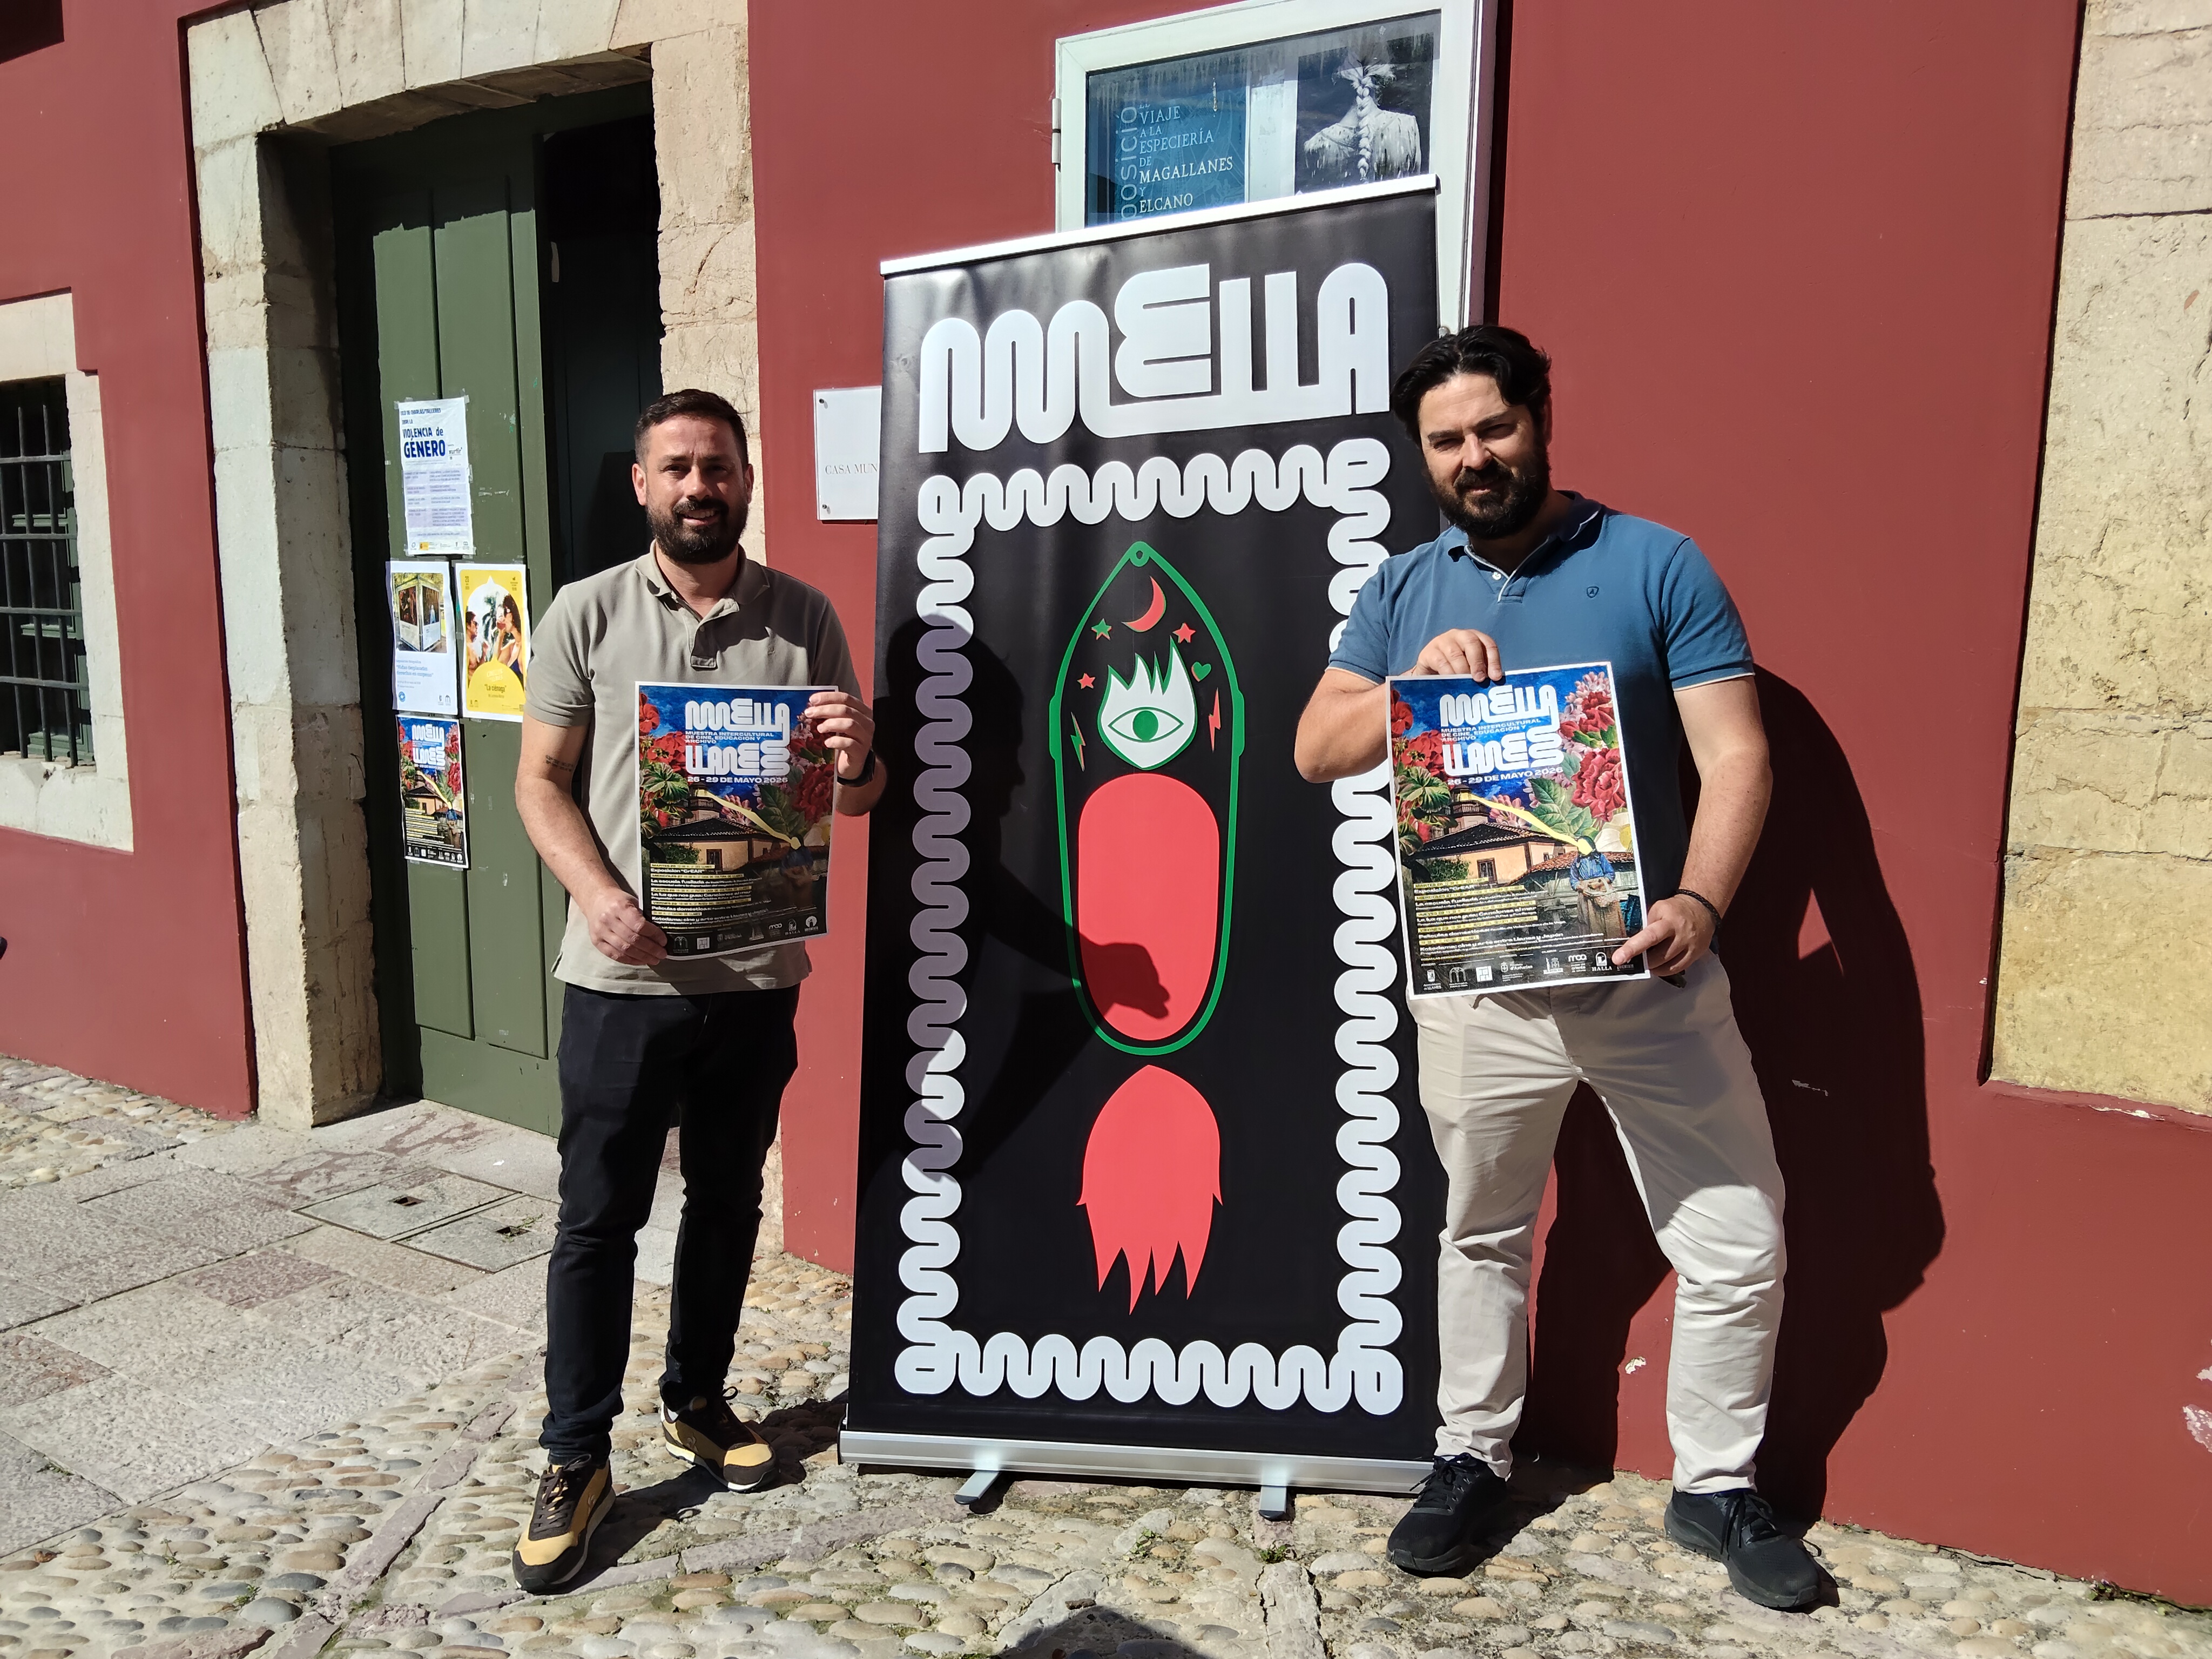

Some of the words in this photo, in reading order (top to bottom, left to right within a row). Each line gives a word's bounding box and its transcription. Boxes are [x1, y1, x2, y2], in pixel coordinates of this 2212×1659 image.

[1139, 106, 1181, 124] VIAJE
[1139, 128, 1147, 138] A
[1149, 125, 1162, 136] LA
[1139, 127, 1214, 154] ESPECIERÍA
[1139, 156, 1152, 167] DE
[1139, 156, 1233, 184] MAGALLANES
[1139, 187, 1146, 197] Y
[1139, 193, 1193, 213] ELCANO
[919, 262, 1390, 453] MELLA
[402, 427, 433, 439] VIOLENCIA
[436, 427, 444, 436] de
[404, 438, 446, 458] GÉNERO
[825, 464, 851, 475] CASA
[685, 698, 790, 732] MELLA
[1440, 684, 1560, 727] MELLA
[1478, 719, 1541, 730] INTERCULTURAL
[685, 740, 790, 775] LLANES
[1442, 726, 1564, 777] LLANES
[1500, 771, 1533, 780] MAYO
[1535, 767, 1563, 776] 2026
